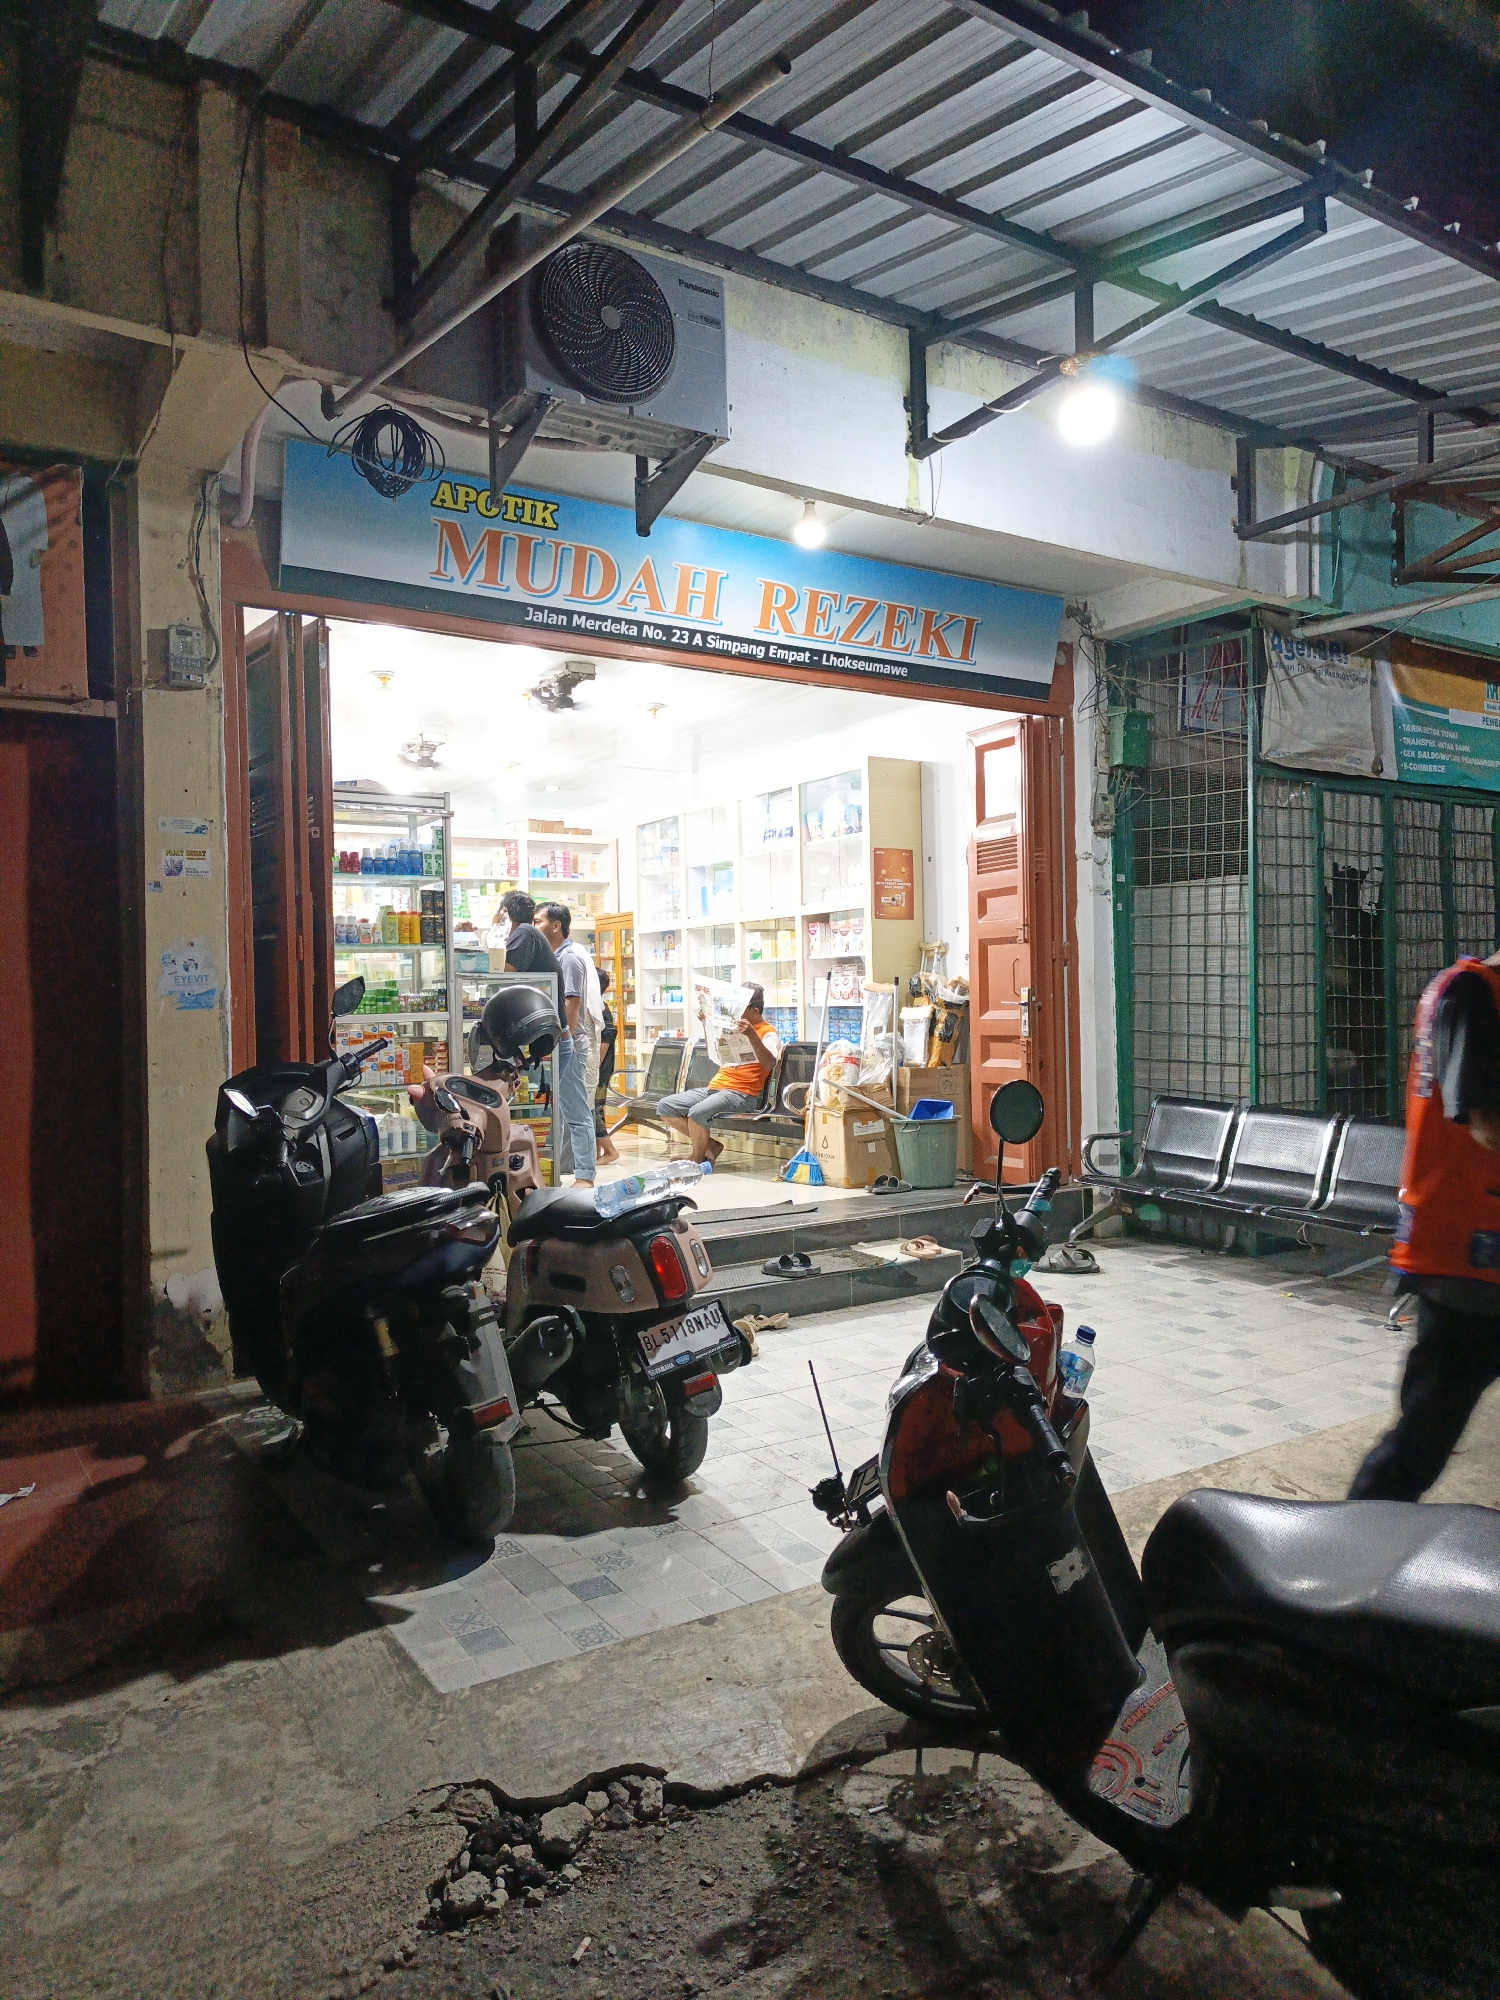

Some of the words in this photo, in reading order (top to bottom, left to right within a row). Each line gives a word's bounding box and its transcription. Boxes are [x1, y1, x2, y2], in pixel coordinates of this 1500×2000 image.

[678, 279, 720, 298] Panasonic
[432, 482, 559, 531] APOTIK
[429, 517, 730, 626] MUDAH
[753, 579, 983, 666] REZEKI
[524, 607, 567, 626] Jalan
[572, 614, 638, 636] Merdeka
[642, 625, 667, 640] No.
[671, 629, 689, 644] 23
[692, 632, 702, 647] A
[706, 635, 765, 658] Simpang
[769, 646, 810, 663] Empat
[822, 654, 908, 677] Lhokseumawe
[174, 974, 210, 984] EYEVIT
